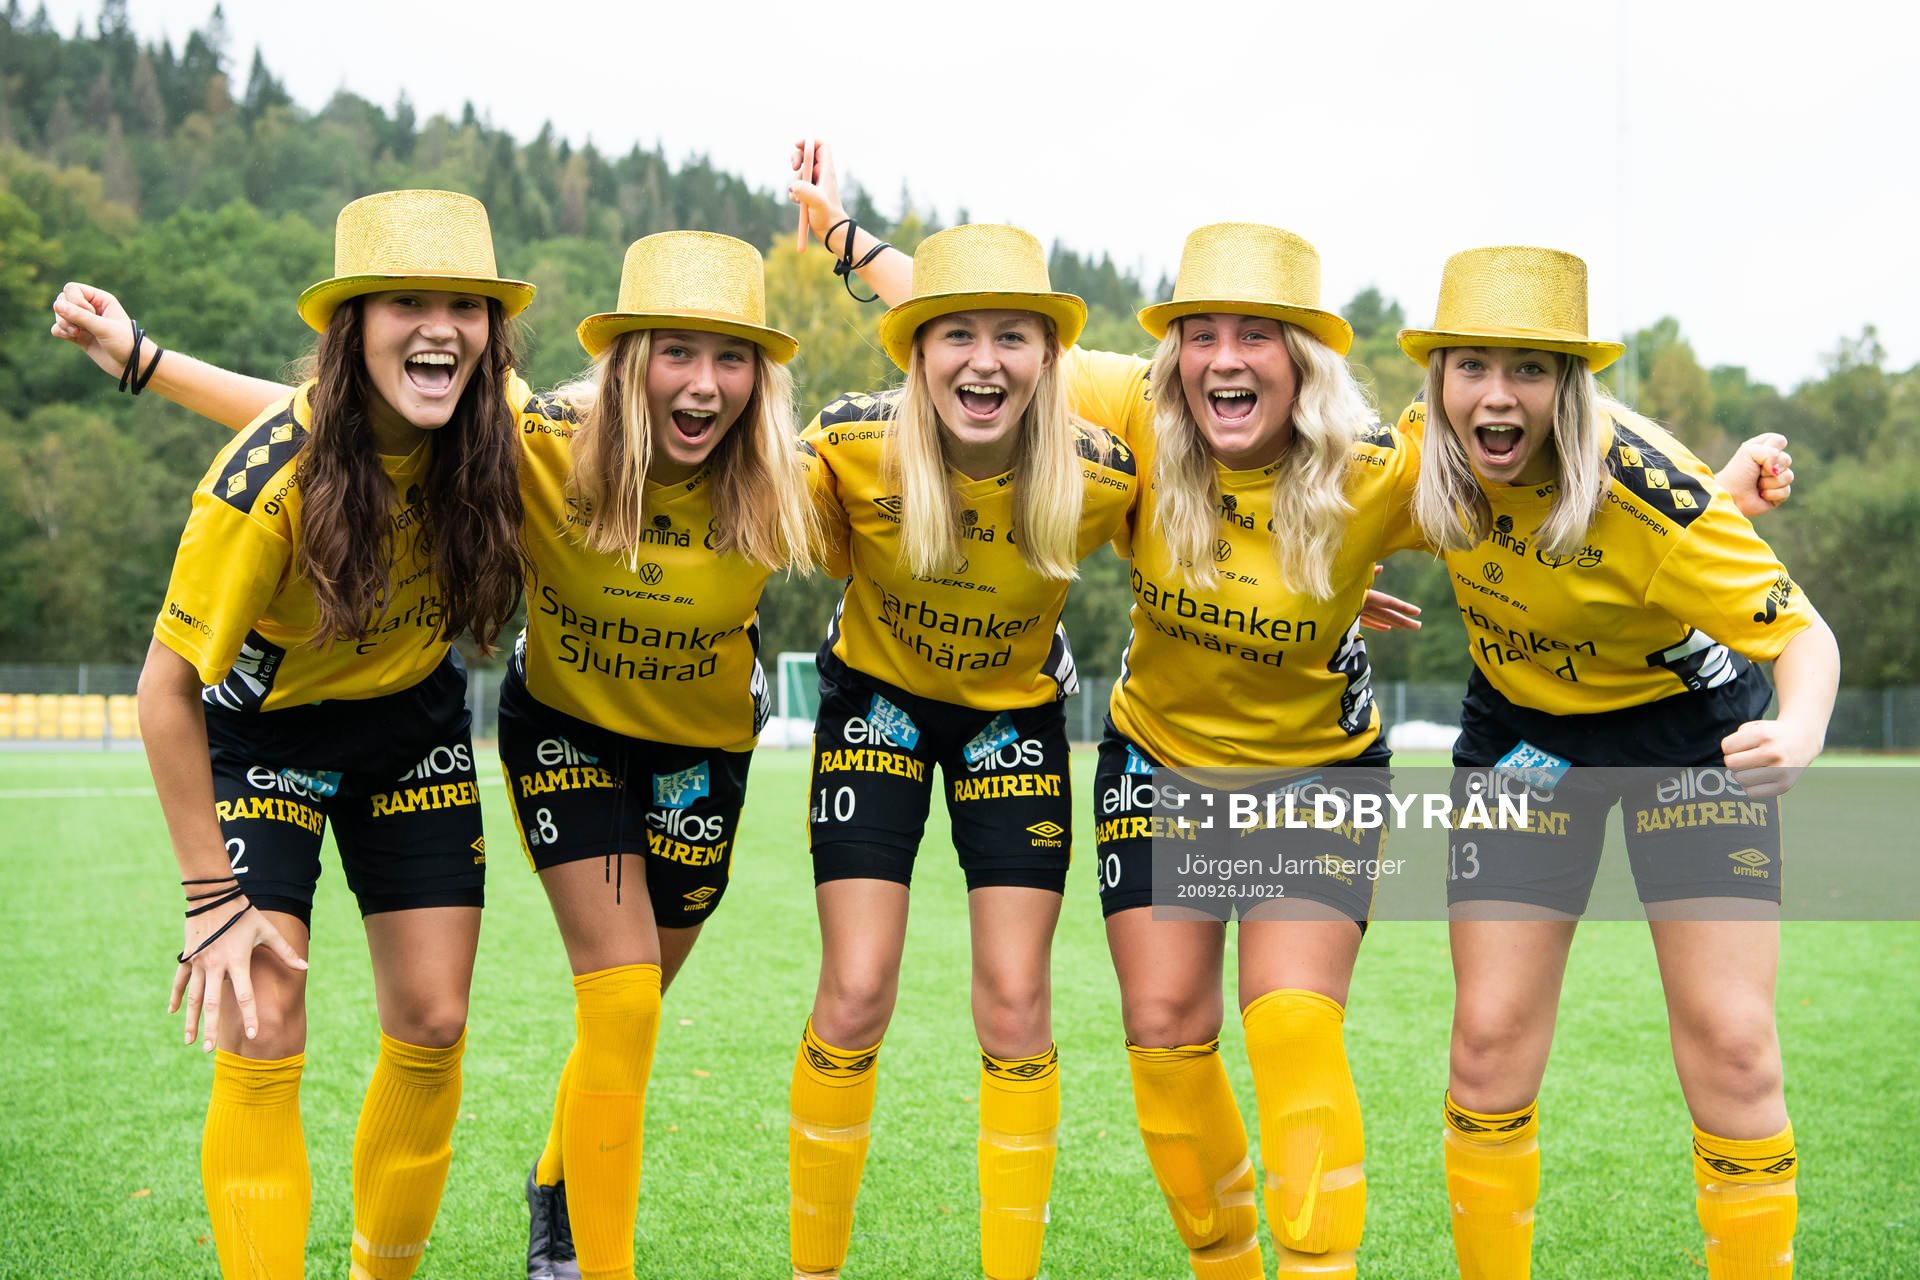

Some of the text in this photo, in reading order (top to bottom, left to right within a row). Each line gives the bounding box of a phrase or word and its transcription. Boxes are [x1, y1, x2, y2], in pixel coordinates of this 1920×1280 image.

[602, 586, 696, 606] TOVEKS BIL
[977, 584, 998, 595] BIL
[1238, 575, 1259, 586] BIL
[1456, 572, 1529, 613] TOVEKS BIL
[558, 634, 718, 683] Sjuhärad
[819, 748, 925, 783] RAMIRENT
[818, 786, 856, 822] 10
[955, 774, 1061, 802] RAMIRENT
[1103, 774, 1183, 814] ellos
[216, 797, 324, 837] RAMIRENT
[536, 808, 558, 845] 8
[1636, 801, 1768, 834] RAMIRENT
[1031, 838, 1063, 848] umbro
[1451, 842, 1480, 880] 13
[1733, 866, 1769, 879] umbro
